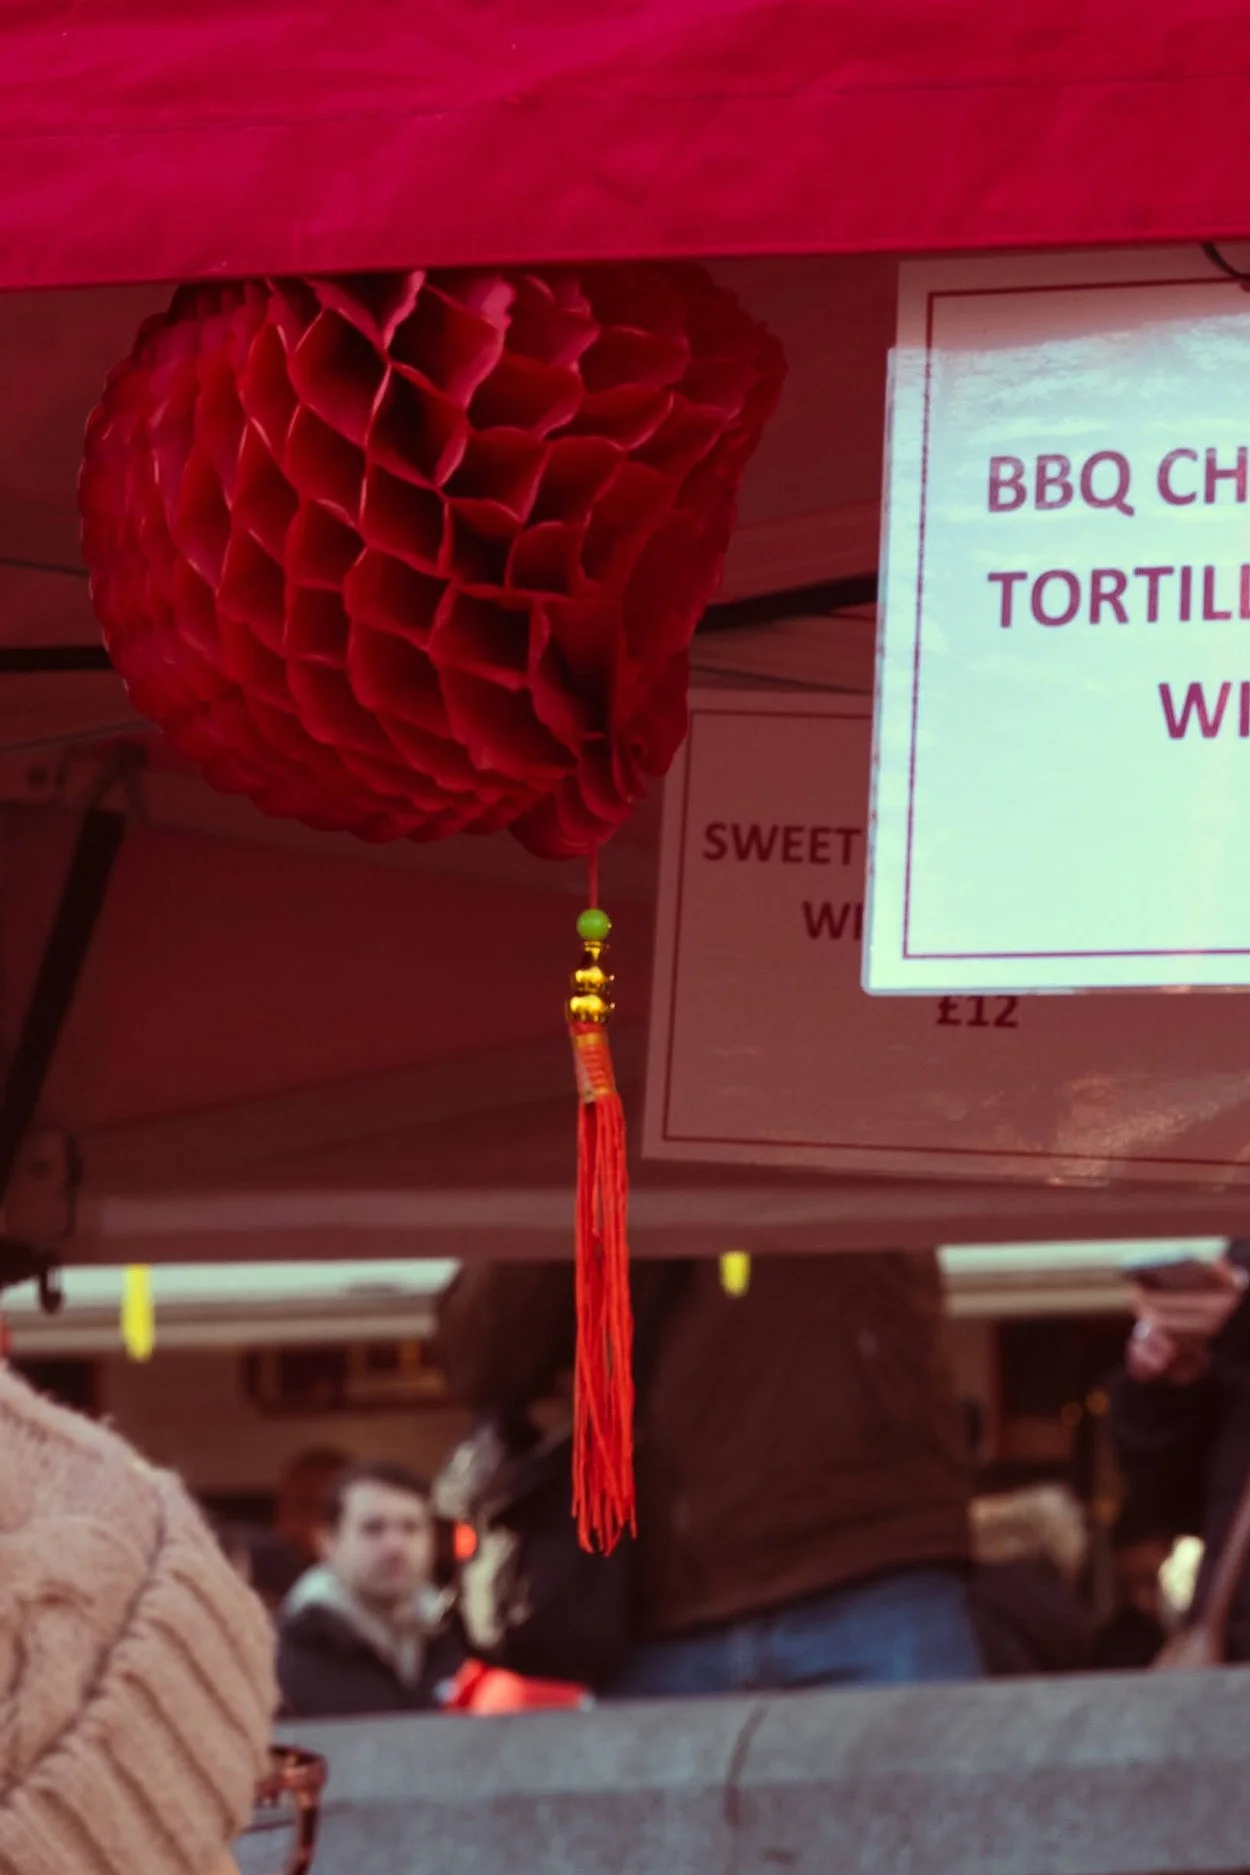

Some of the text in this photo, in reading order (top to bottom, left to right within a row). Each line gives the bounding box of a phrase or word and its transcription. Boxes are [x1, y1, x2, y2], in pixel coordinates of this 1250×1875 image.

[986, 448, 1136, 518] BBQ
[703, 821, 861, 865] SWEET
[935, 995, 1019, 1029] £12
